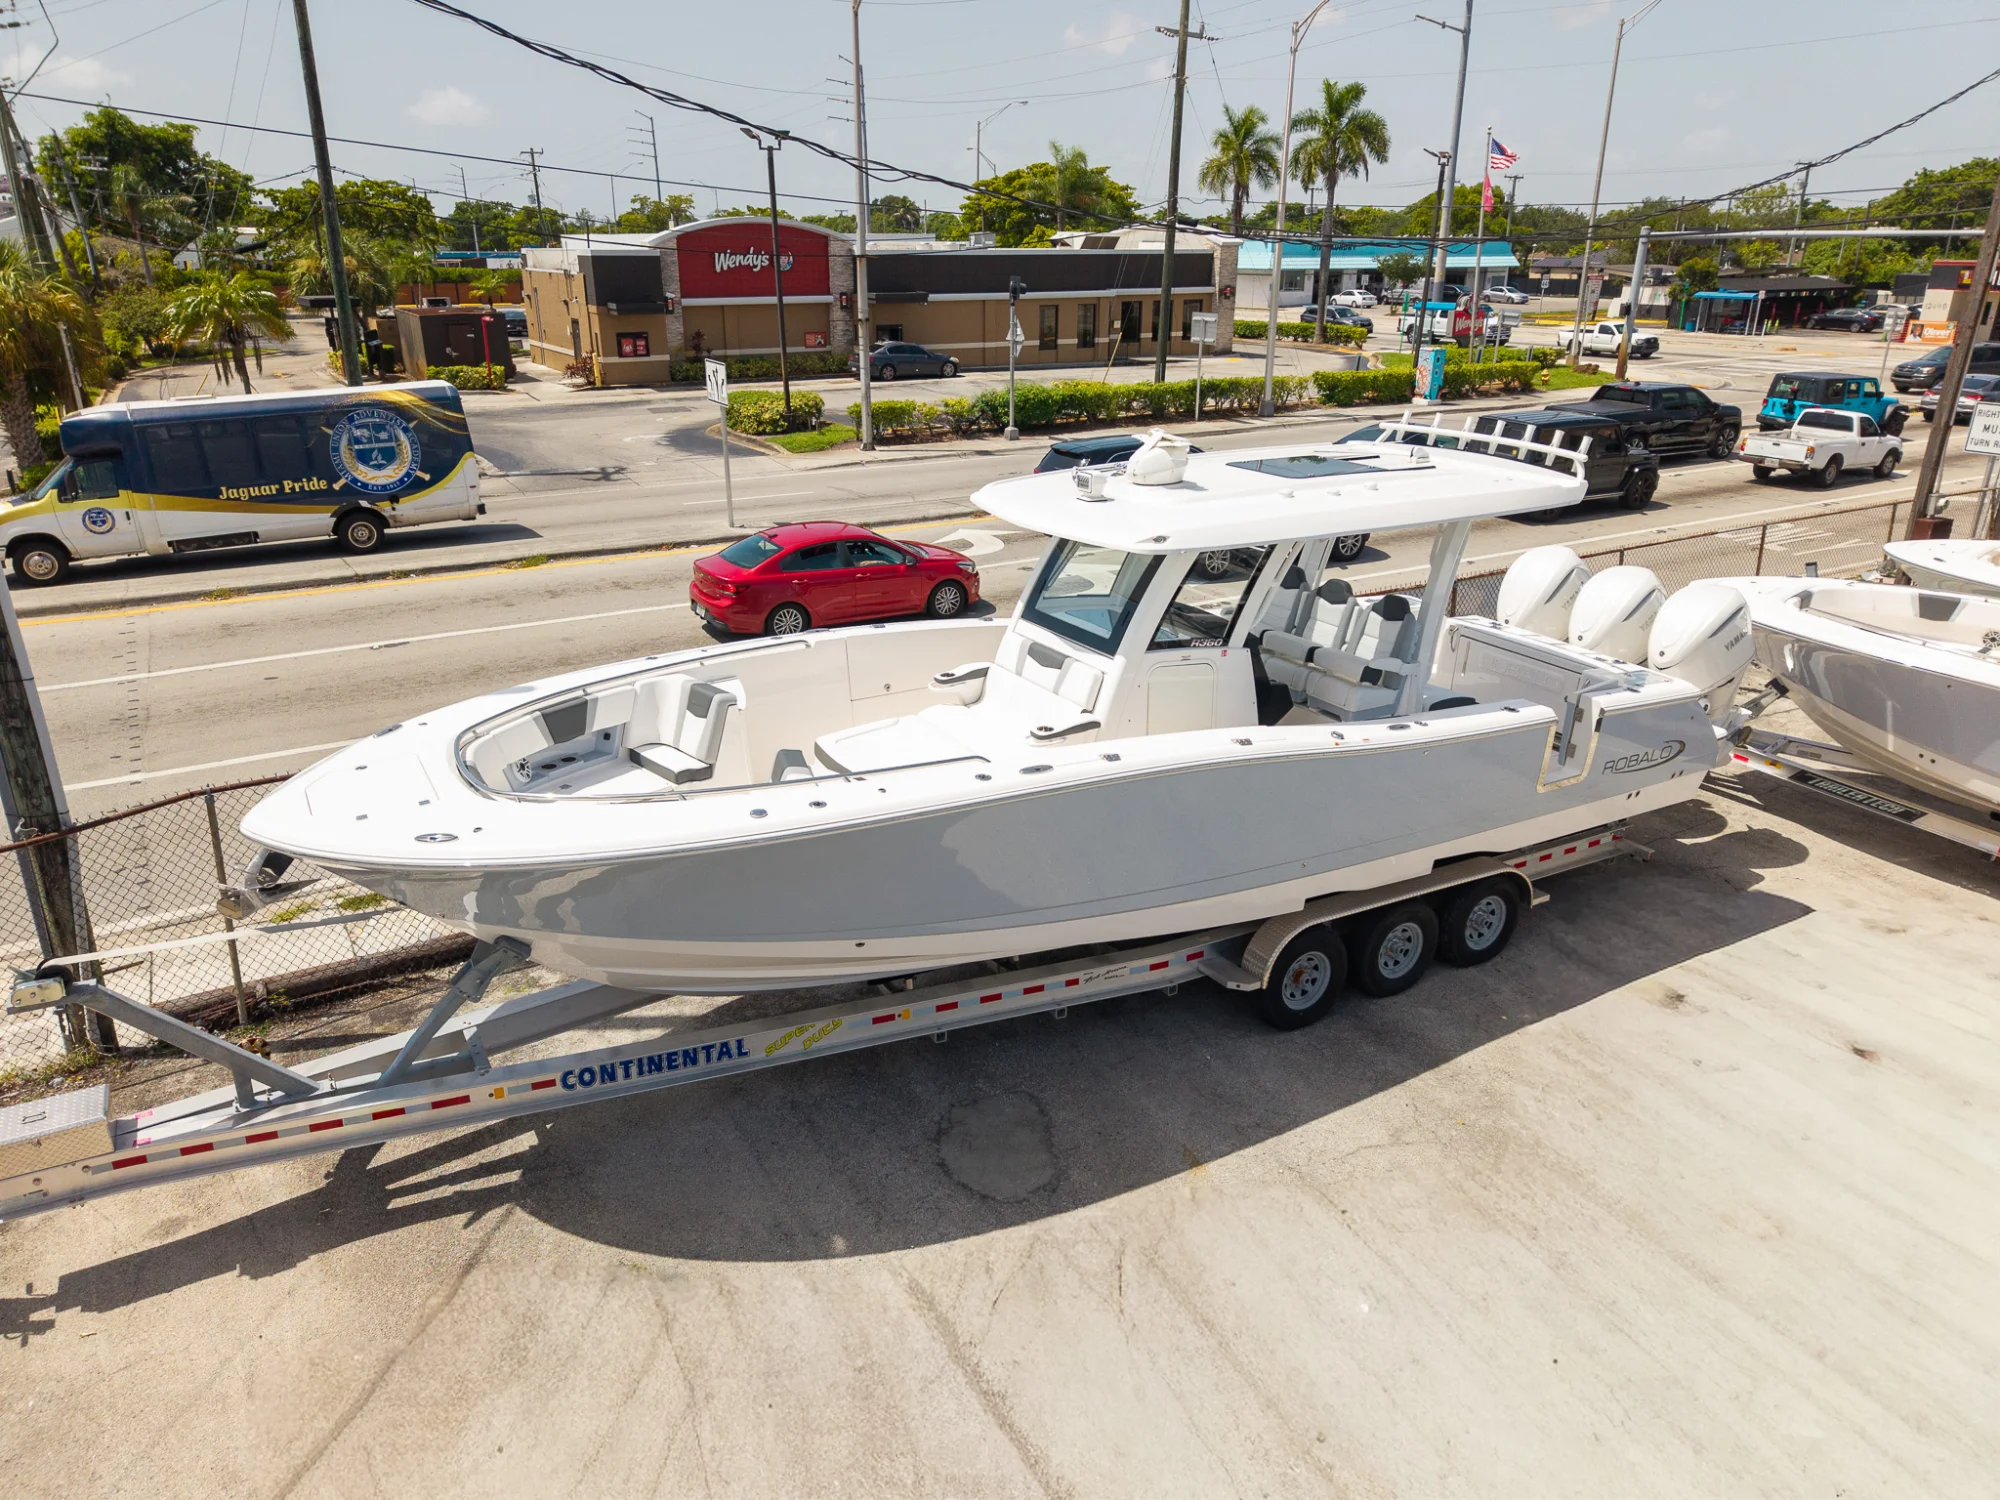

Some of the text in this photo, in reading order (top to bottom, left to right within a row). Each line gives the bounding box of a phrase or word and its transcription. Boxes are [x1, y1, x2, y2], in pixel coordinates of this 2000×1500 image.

[714, 246, 770, 273] Wendy's
[1970, 437, 1990, 448] TURN
[1982, 423, 2000, 435] MU
[331, 410, 419, 481] MIAMI UNION ADVENTIST ACADEMY
[219, 476, 328, 501] Jaguar Pride
[1602, 745, 1673, 775] ROBALO
[560, 1038, 750, 1091] CONTINENTAL
